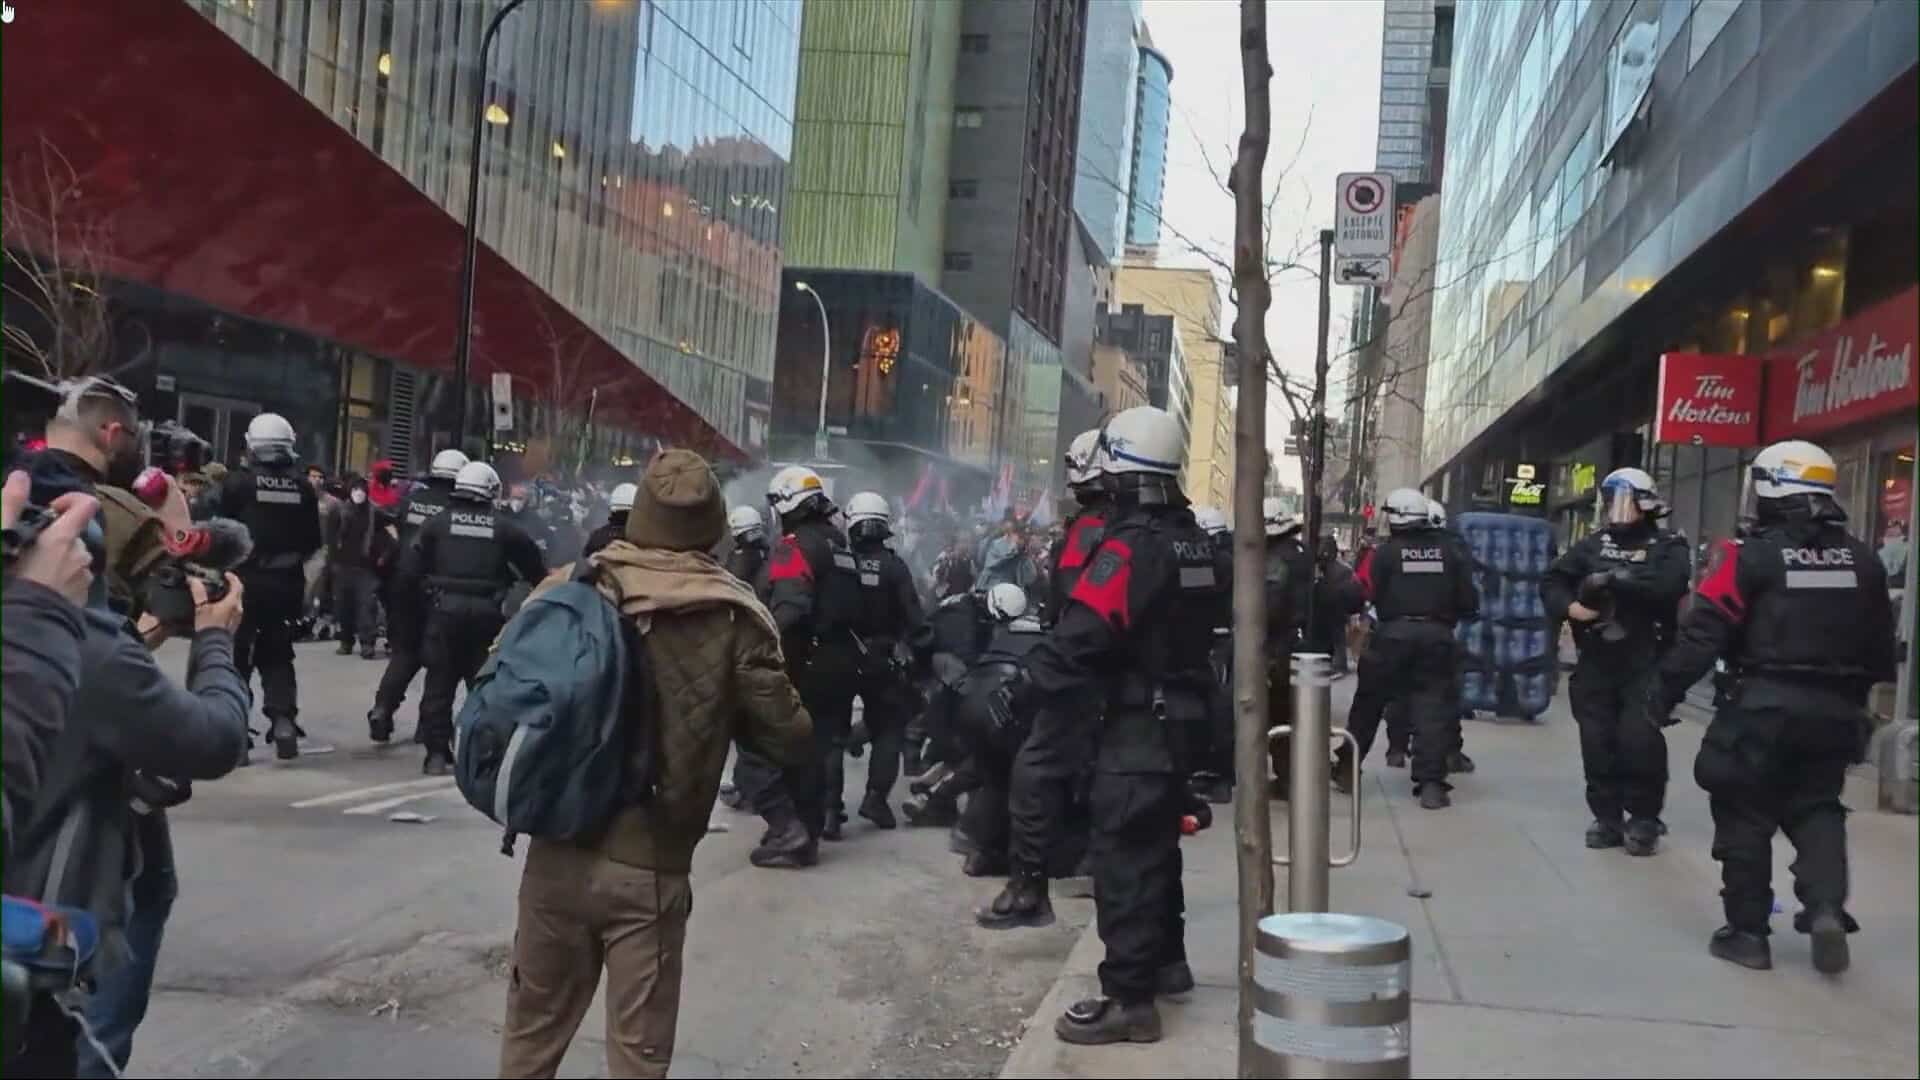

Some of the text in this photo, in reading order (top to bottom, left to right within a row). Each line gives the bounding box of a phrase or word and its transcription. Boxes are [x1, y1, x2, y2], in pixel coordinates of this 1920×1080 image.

[1695, 375, 1735, 399] Tim
[1794, 333, 1911, 424] Tim Hortons
[1668, 398, 1751, 425] Hortons
[256, 475, 298, 489] POLIC
[451, 513, 495, 526] POLICE
[1401, 548, 1443, 560] POLICE
[1781, 548, 1855, 567] POLICE
